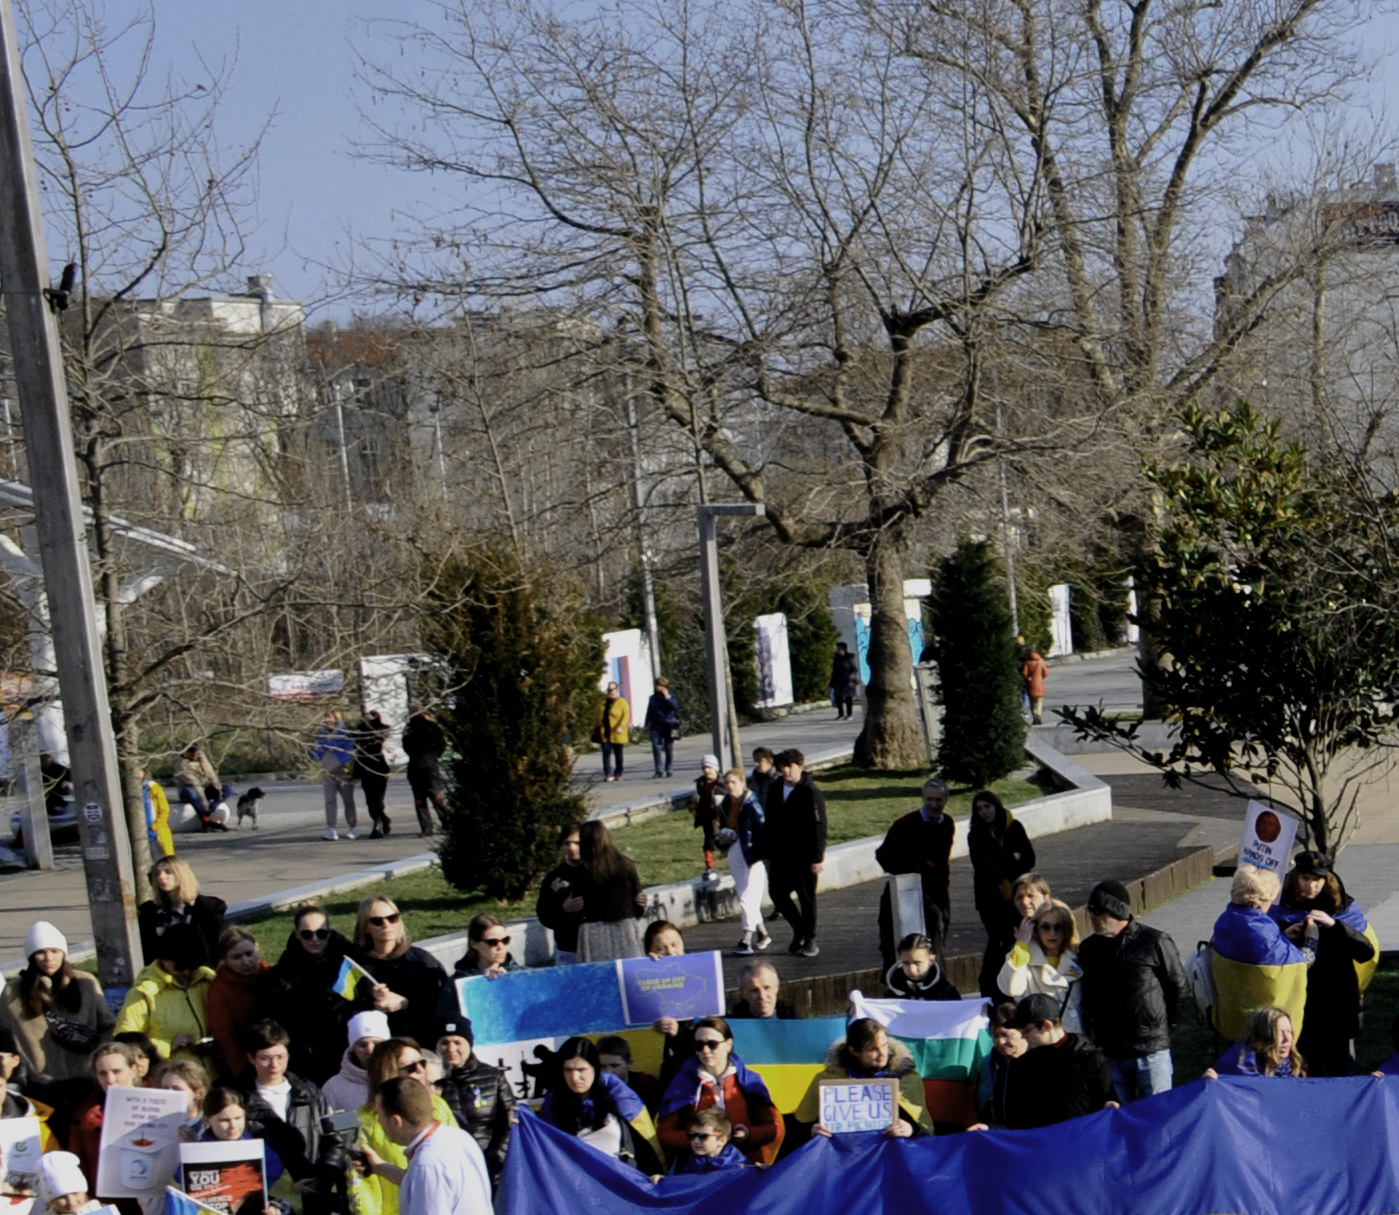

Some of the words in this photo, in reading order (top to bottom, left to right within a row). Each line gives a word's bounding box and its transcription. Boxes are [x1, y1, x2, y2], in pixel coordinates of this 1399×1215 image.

[1243, 847, 1264, 863] HANDS
[1265, 857, 1280, 869] OFF
[1252, 840, 1273, 856] PUTIN
[823, 1084, 892, 1104] PLEASE
[823, 1103, 862, 1122] GIVE
[868, 1101, 892, 1120] US
[189, 1170, 221, 1185] YOU
